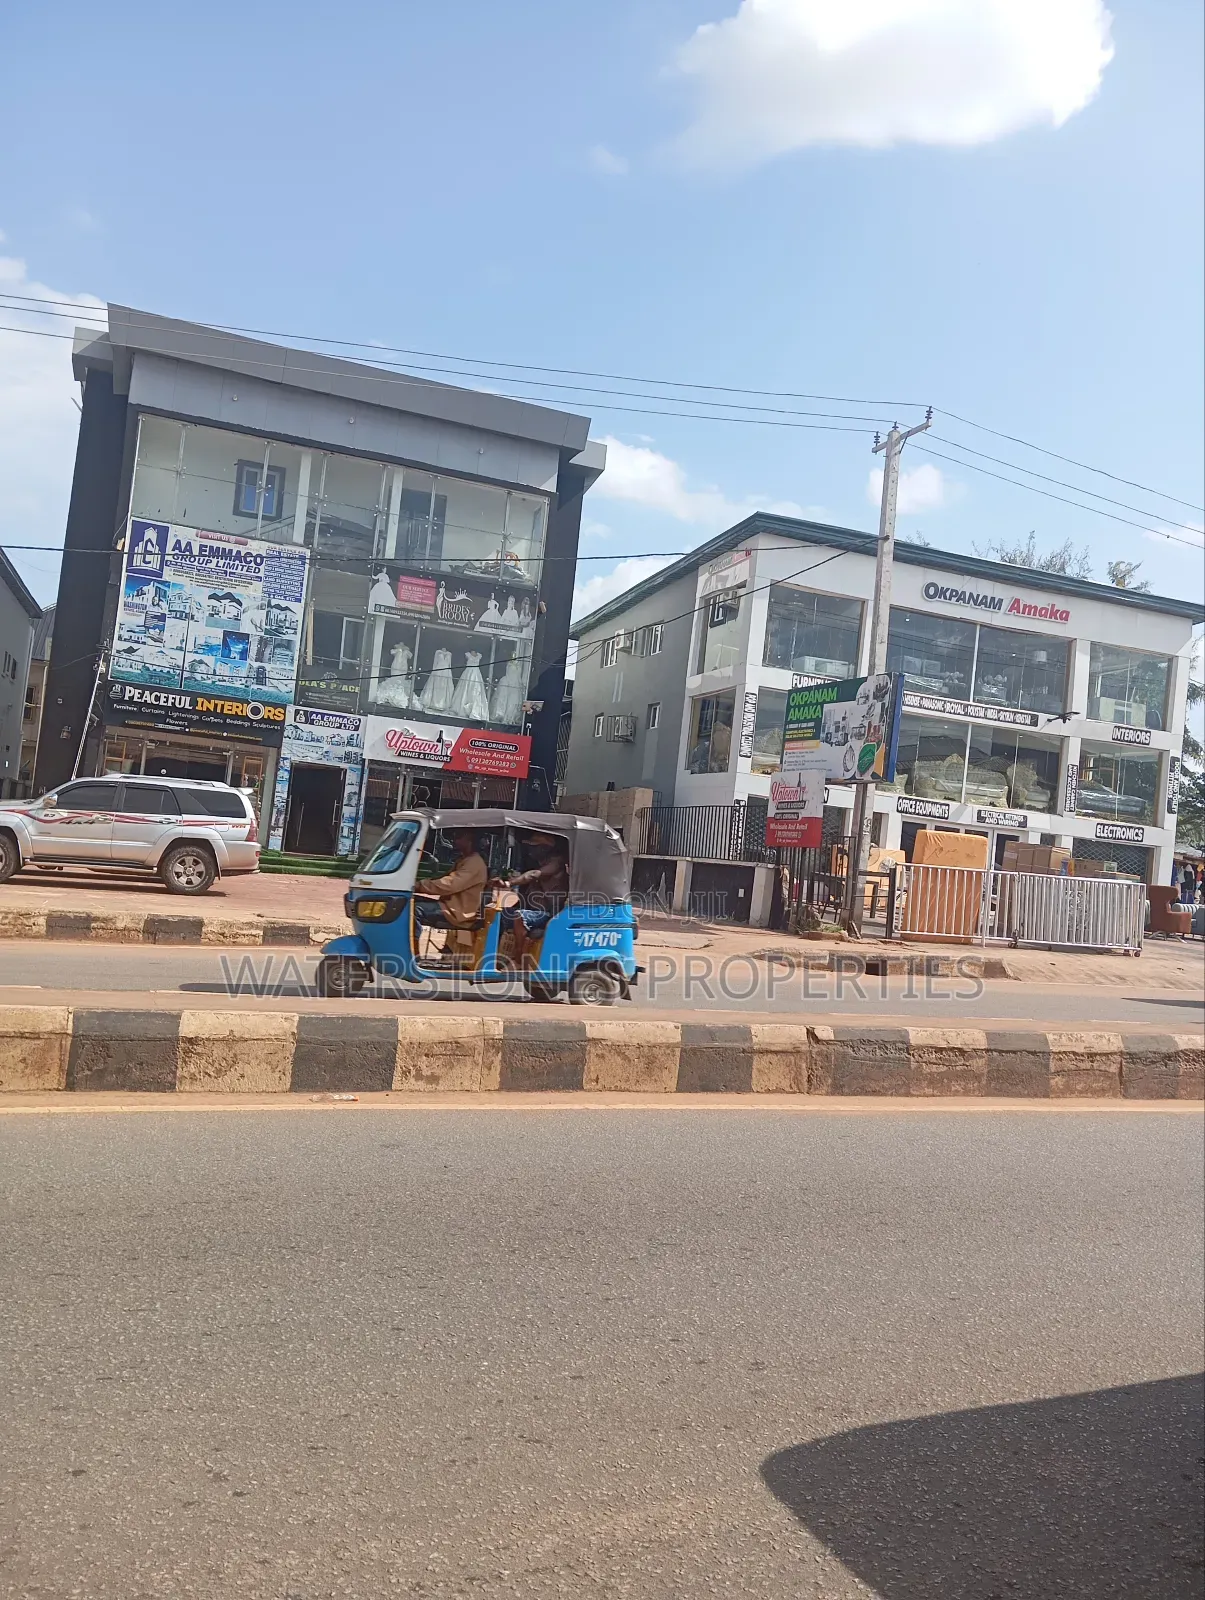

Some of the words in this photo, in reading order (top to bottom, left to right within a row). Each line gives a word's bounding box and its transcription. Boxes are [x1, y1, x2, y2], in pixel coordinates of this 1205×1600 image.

[171, 539, 194, 555] AA
[198, 544, 264, 566] EMMACO
[172, 553, 212, 566] GROUP
[215, 560, 260, 574] LIMITED
[443, 602, 470, 613] BRIDES
[924, 582, 1003, 610] OKPANAM
[1008, 598, 1070, 622] Amaka
[442, 611, 469, 622] ROOM
[124, 686, 193, 709] PEACEFUL
[196, 697, 284, 721] INTERIORS
[789, 687, 838, 706] OKPANAM
[141, 707, 165, 715] Curtains
[226, 718, 250, 727] Beddings
[324, 716, 359, 726] EMMACO
[788, 705, 822, 721] AMAKA
[166, 718, 188, 726] Flowers
[314, 720, 339, 728] GROUP
[386, 729, 440, 754] Uptown
[1112, 726, 1150, 744] INTERIORS
[459, 748, 491, 756] Wholesale
[488, 743, 516, 751] ORIGINAL
[425, 754, 451, 762] LIQUORS
[898, 799, 915, 814] OFFICE
[916, 801, 949, 818] EQUIPMENTS
[999, 819, 1019, 827] WIRING
[1097, 824, 1143, 841] ELECTRONICS
